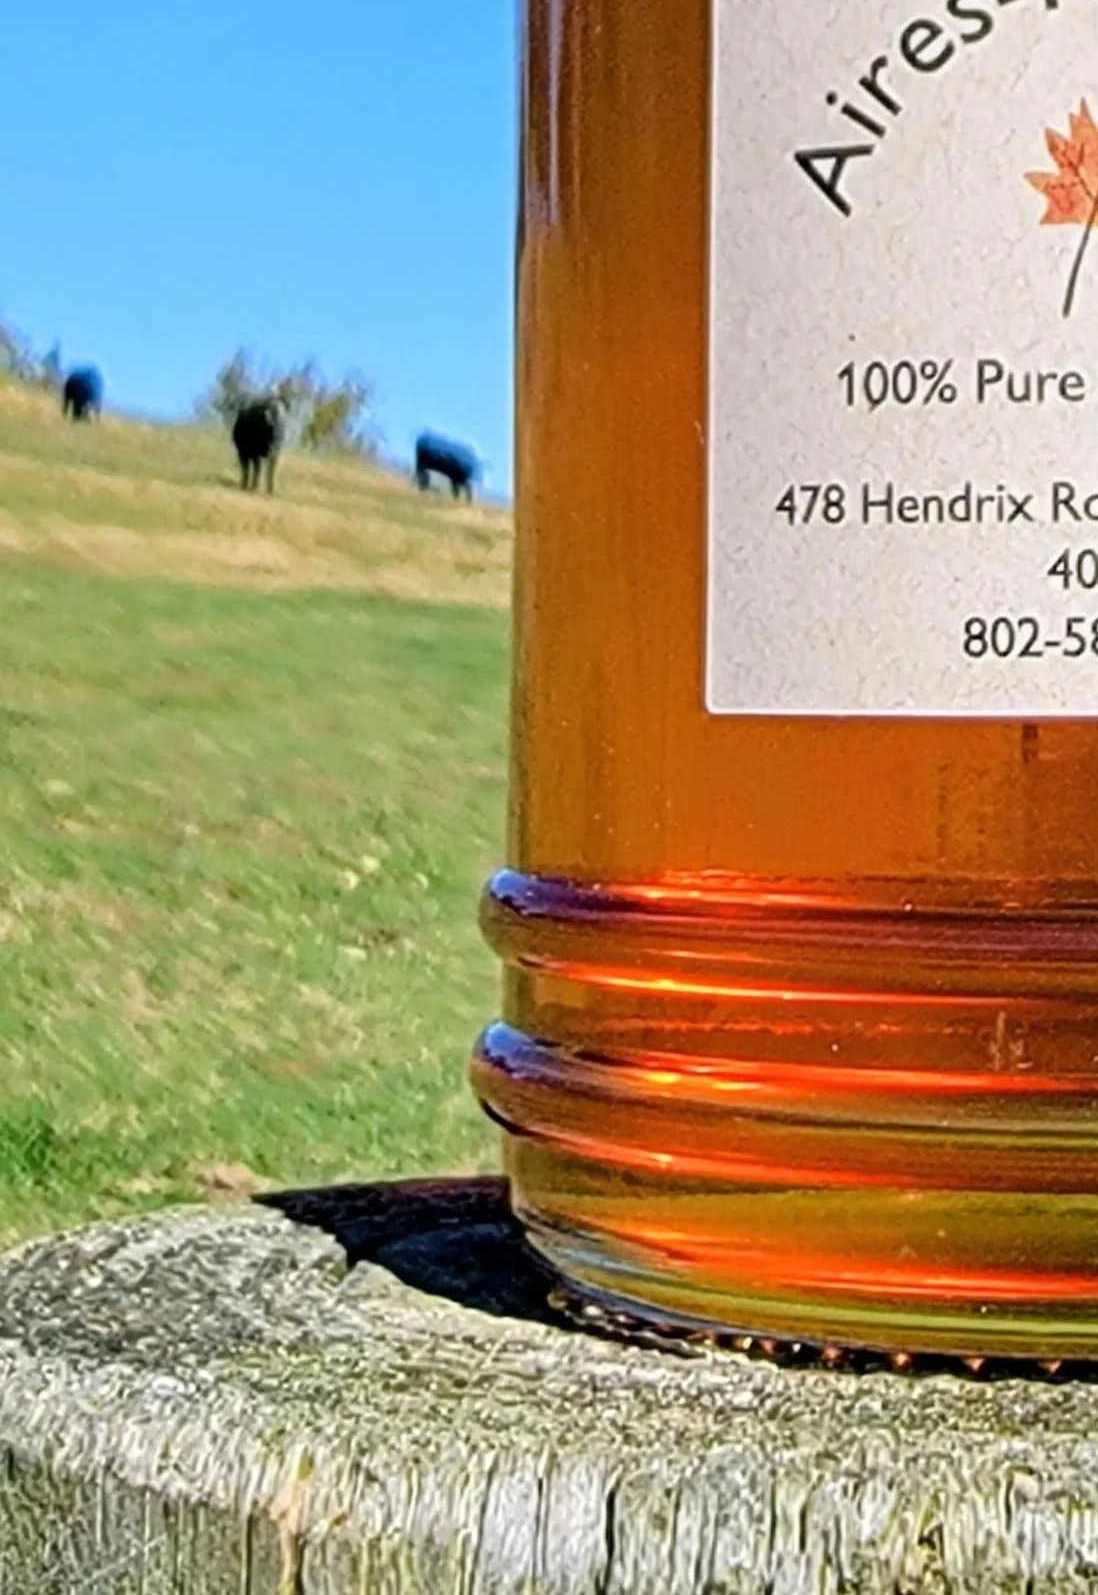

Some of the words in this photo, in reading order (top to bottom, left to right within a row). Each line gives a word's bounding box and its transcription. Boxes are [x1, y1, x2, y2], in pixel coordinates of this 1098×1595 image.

[837, 359, 958, 411] 100%
[976, 359, 1085, 404] Pure
[774, 484, 846, 526] 478
[861, 482, 1034, 525] Hendrix
